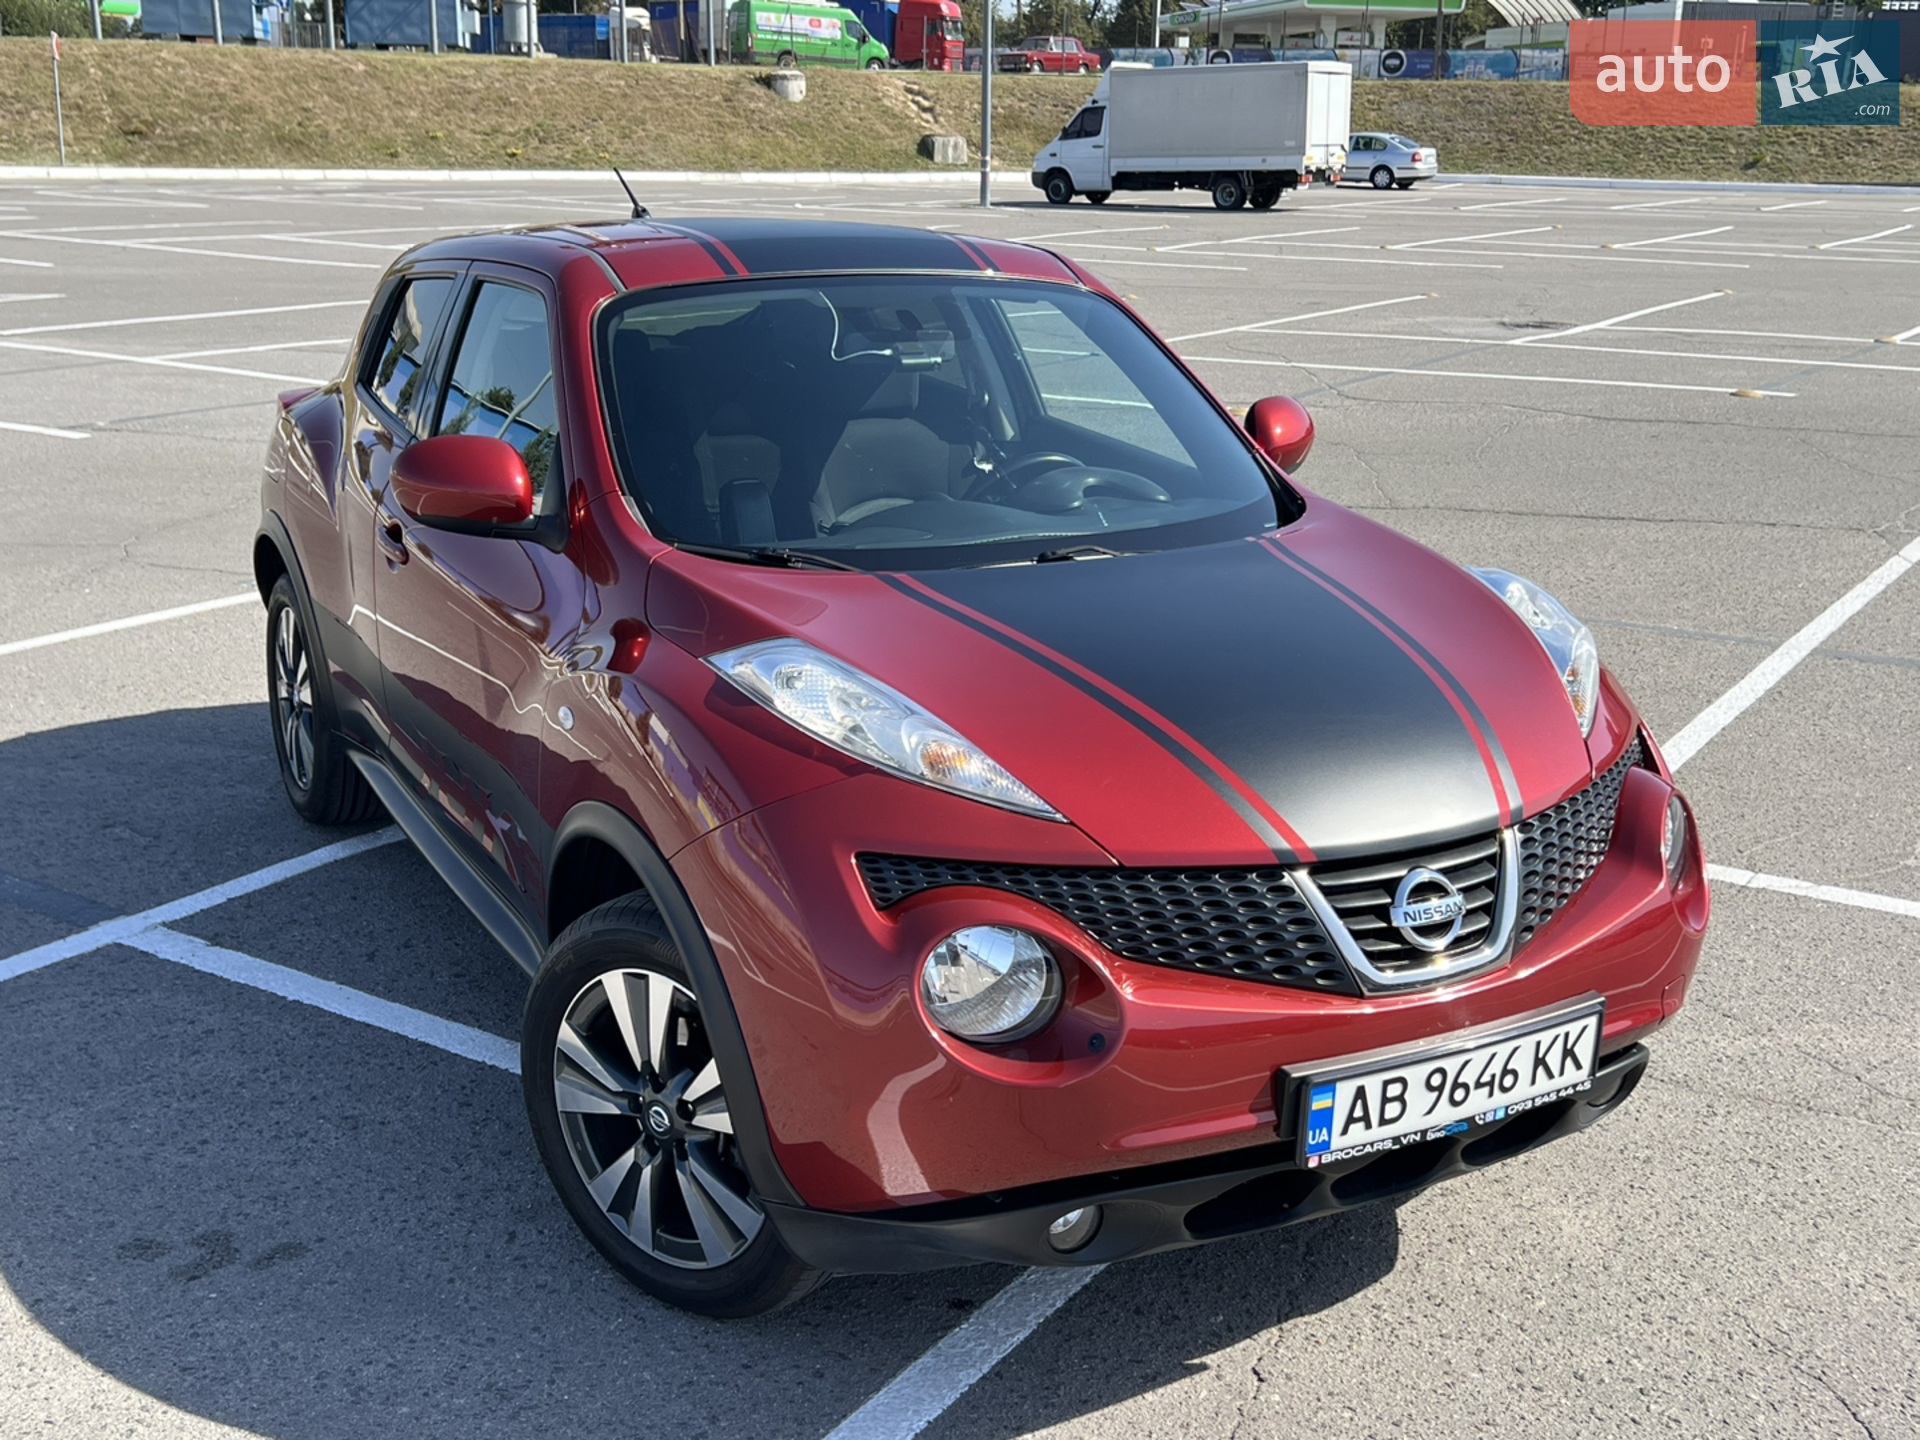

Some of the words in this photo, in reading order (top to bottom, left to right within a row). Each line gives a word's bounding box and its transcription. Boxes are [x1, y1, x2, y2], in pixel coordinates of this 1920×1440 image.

[1403, 901, 1464, 923] NISSAN
[1340, 1076, 1409, 1138] AB
[1422, 1045, 1521, 1117] 9646
[1530, 1024, 1589, 1087] KK
[1507, 1099, 1532, 1115] 093
[1534, 1091, 1557, 1106] 545
[1558, 1086, 1575, 1098] 44
[1575, 1080, 1592, 1092] 45
[1308, 1127, 1329, 1145] UA
[1320, 1132, 1421, 1164] BROCARS_VN
